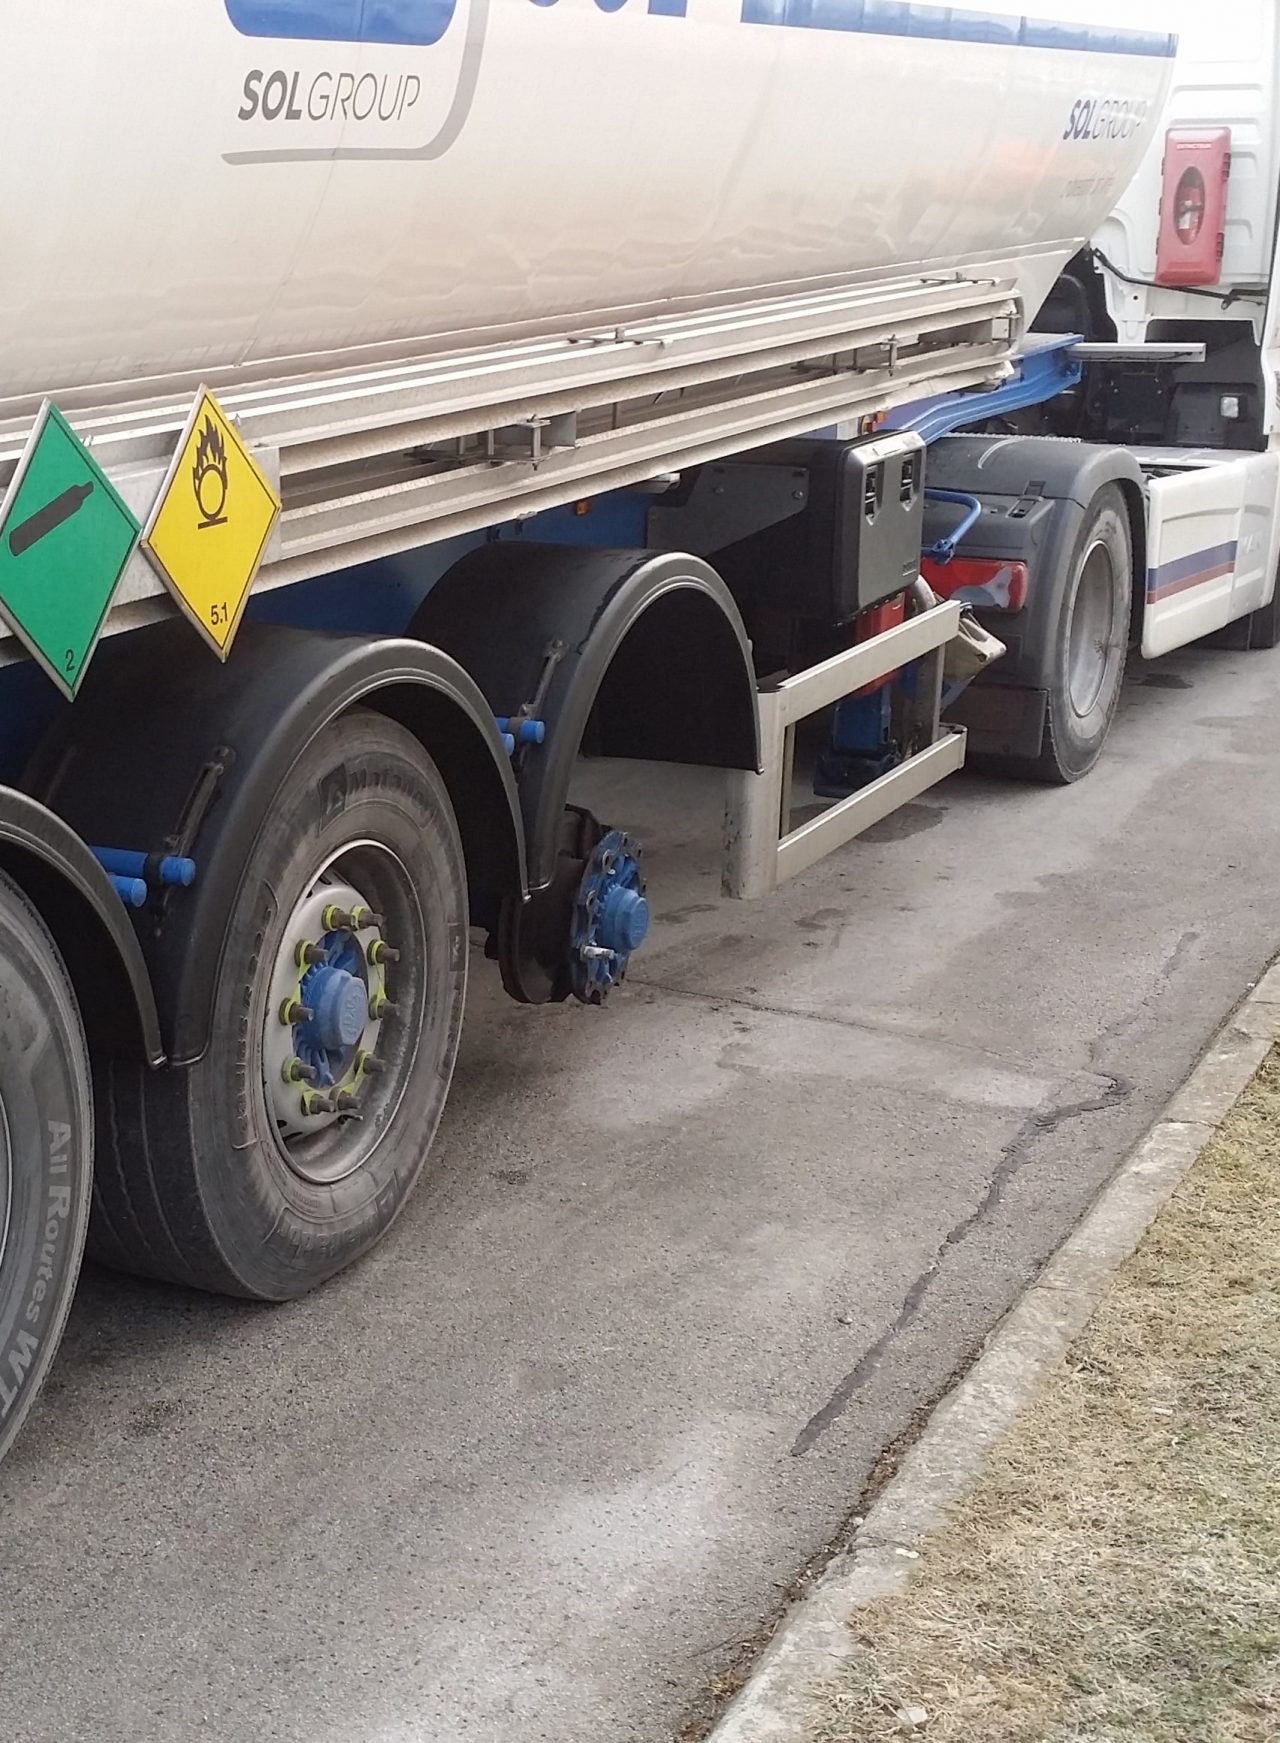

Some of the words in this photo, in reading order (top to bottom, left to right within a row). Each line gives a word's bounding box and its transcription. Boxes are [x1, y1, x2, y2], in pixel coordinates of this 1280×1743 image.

[237, 69, 421, 121] SOLGROUP
[210, 602, 229, 626] 5.1
[64, 648, 76, 672] 2
[47, 1120, 72, 1174] All
[24, 1185, 71, 1324] Routes
